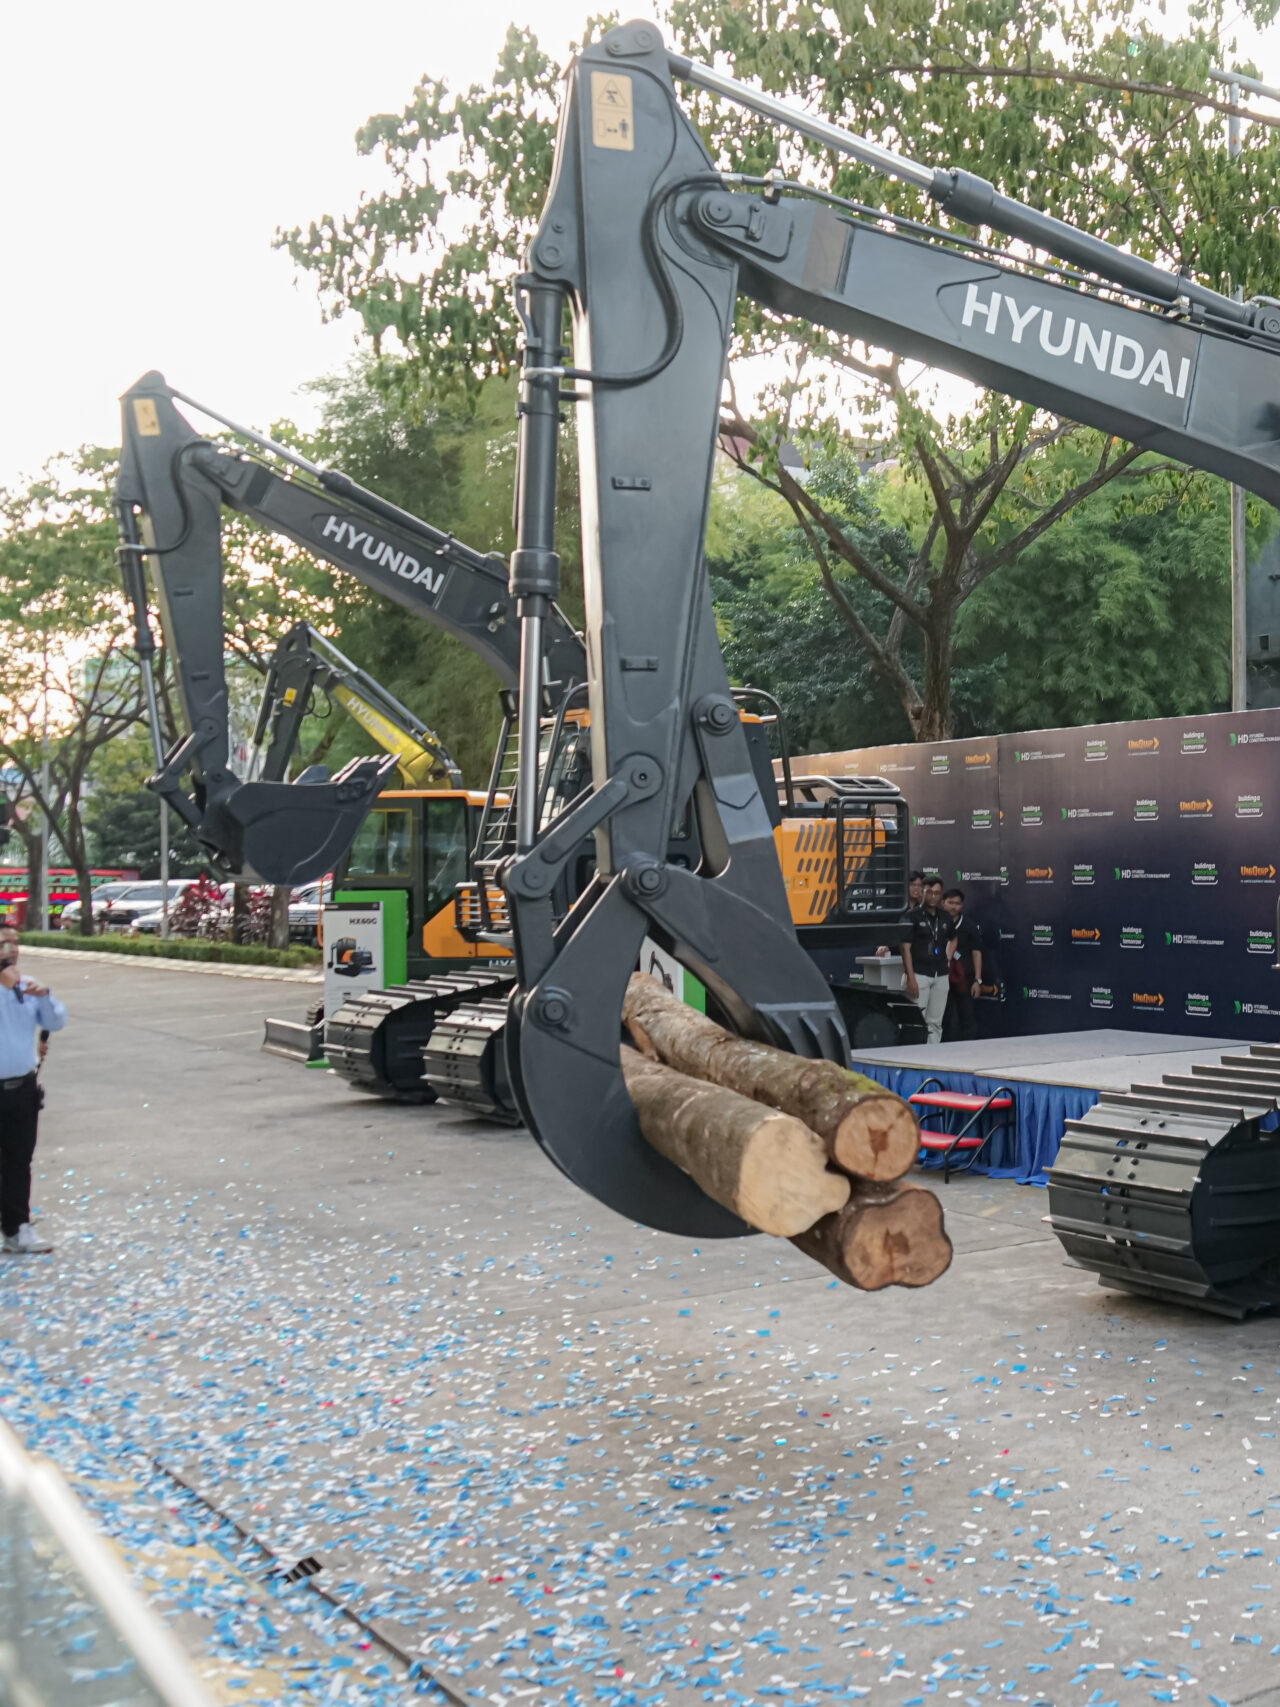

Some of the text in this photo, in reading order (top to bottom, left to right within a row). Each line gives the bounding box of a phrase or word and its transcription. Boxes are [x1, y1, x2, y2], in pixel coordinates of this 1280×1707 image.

[961, 283, 1190, 399] HYUNDAI
[322, 515, 445, 594] HYUNDAI
[1237, 735, 1249, 744] HD
[1121, 869, 1132, 879] HD
[1172, 934, 1183, 944] HD
[1242, 1003, 1253, 1014] HD
